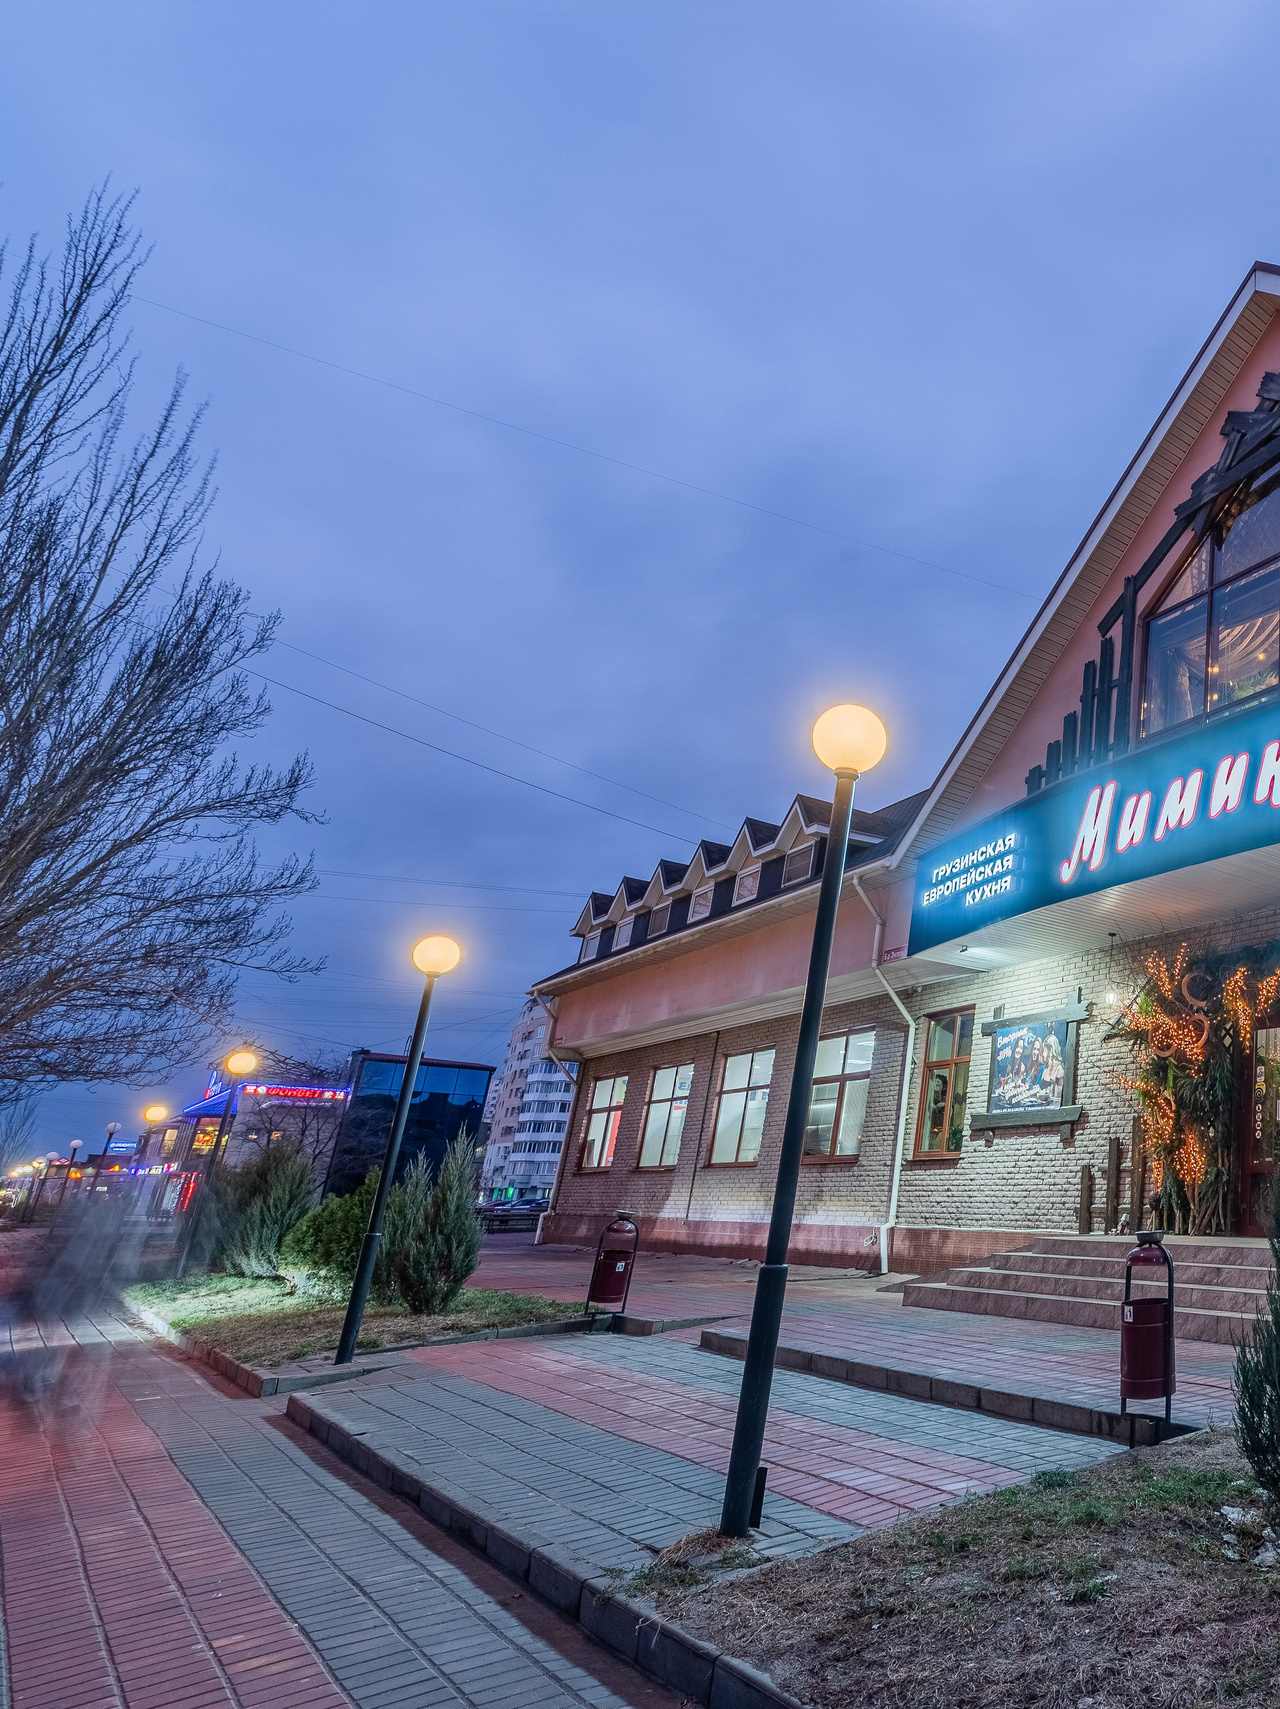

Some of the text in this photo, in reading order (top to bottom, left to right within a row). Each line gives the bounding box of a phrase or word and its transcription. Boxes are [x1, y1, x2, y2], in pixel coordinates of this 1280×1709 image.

[923, 854, 1014, 906] ЕВРОПЕЙСКАЯ
[932, 832, 1016, 883] ГРУЗИНСКАЯ
[965, 875, 1012, 907] КУХНЯ
